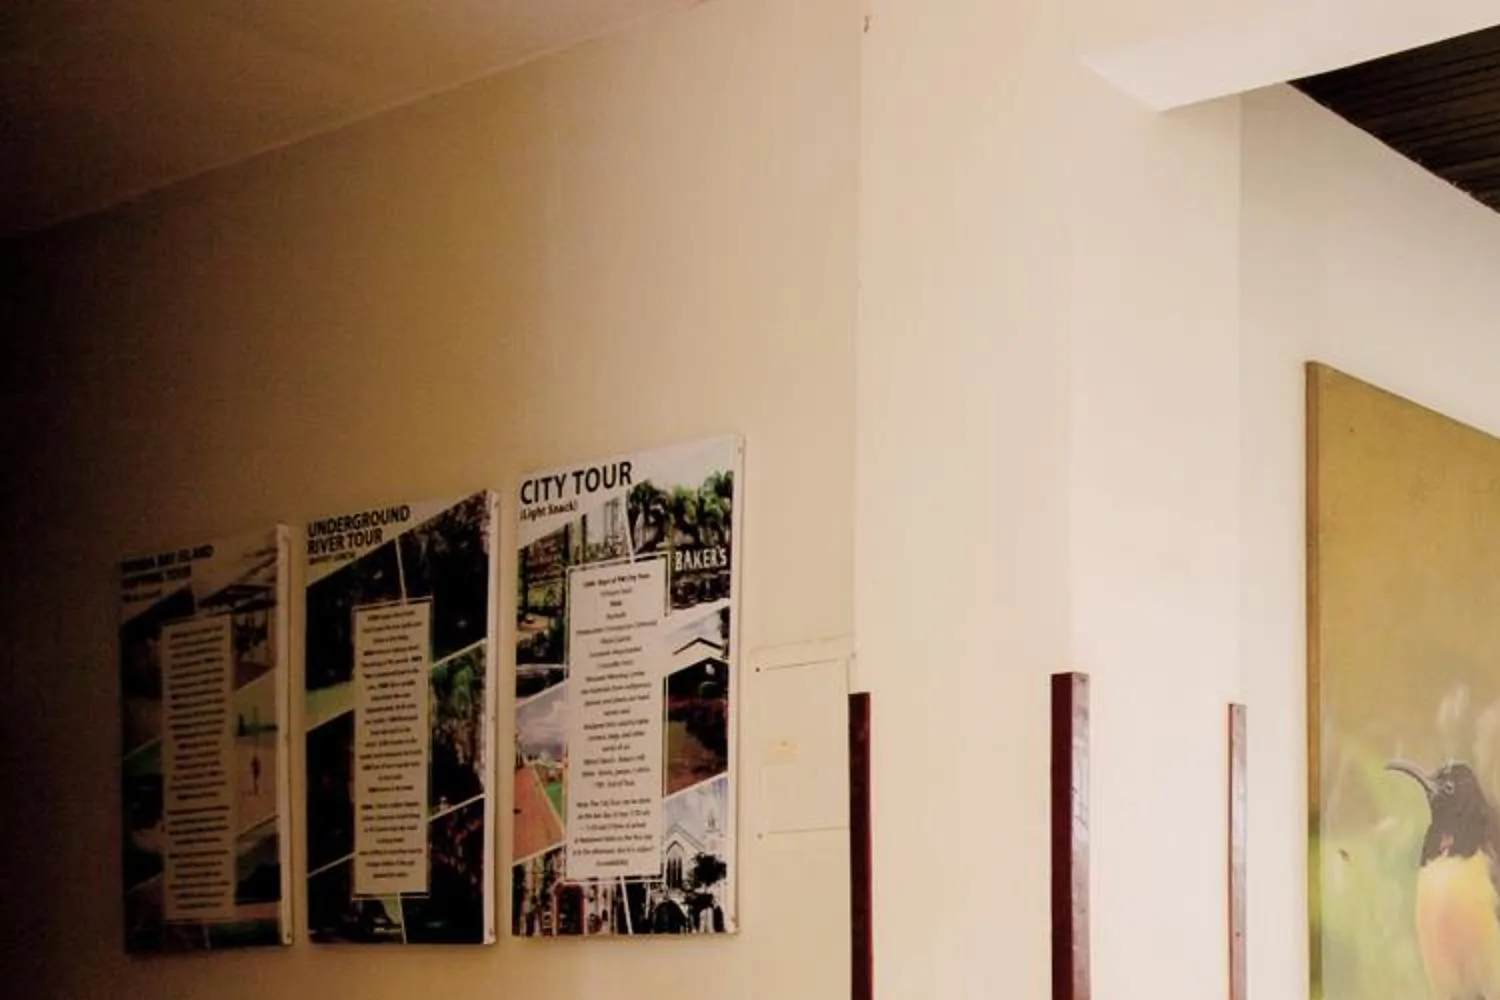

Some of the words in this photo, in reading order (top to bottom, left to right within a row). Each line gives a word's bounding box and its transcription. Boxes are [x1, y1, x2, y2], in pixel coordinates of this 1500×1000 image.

[521, 473, 567, 505] CITY
[572, 462, 632, 495] TOUR
[307, 505, 410, 538] UNDERGROUND
[307, 534, 345, 555] RIVER
[347, 528, 383, 548] TOUR
[675, 546, 727, 571] BAKER'S
